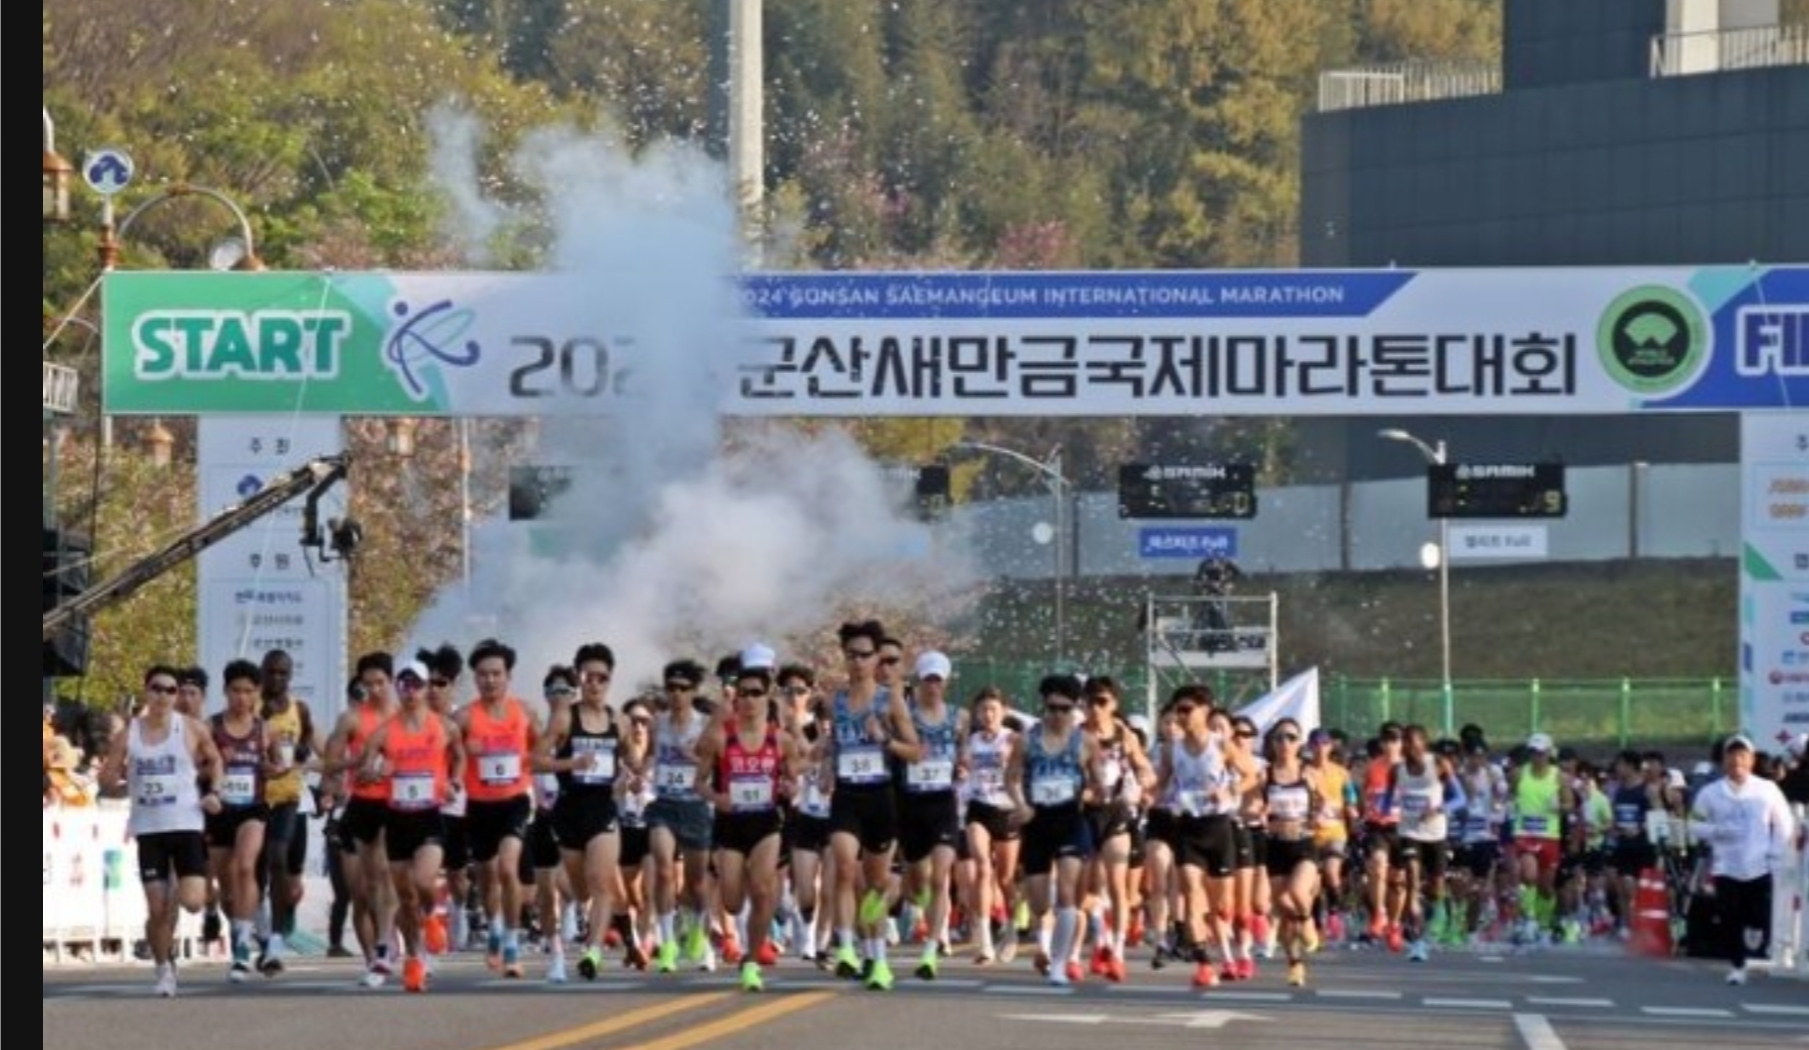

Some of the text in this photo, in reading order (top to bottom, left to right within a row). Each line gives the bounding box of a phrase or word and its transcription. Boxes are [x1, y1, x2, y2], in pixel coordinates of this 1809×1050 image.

[738, 287, 783, 305] 024
[885, 286, 1037, 306] SAEMANGEUM
[1044, 286, 1213, 305] INTERNATIONAL
[1220, 286, 1343, 303] MARATHON
[135, 313, 347, 376] START
